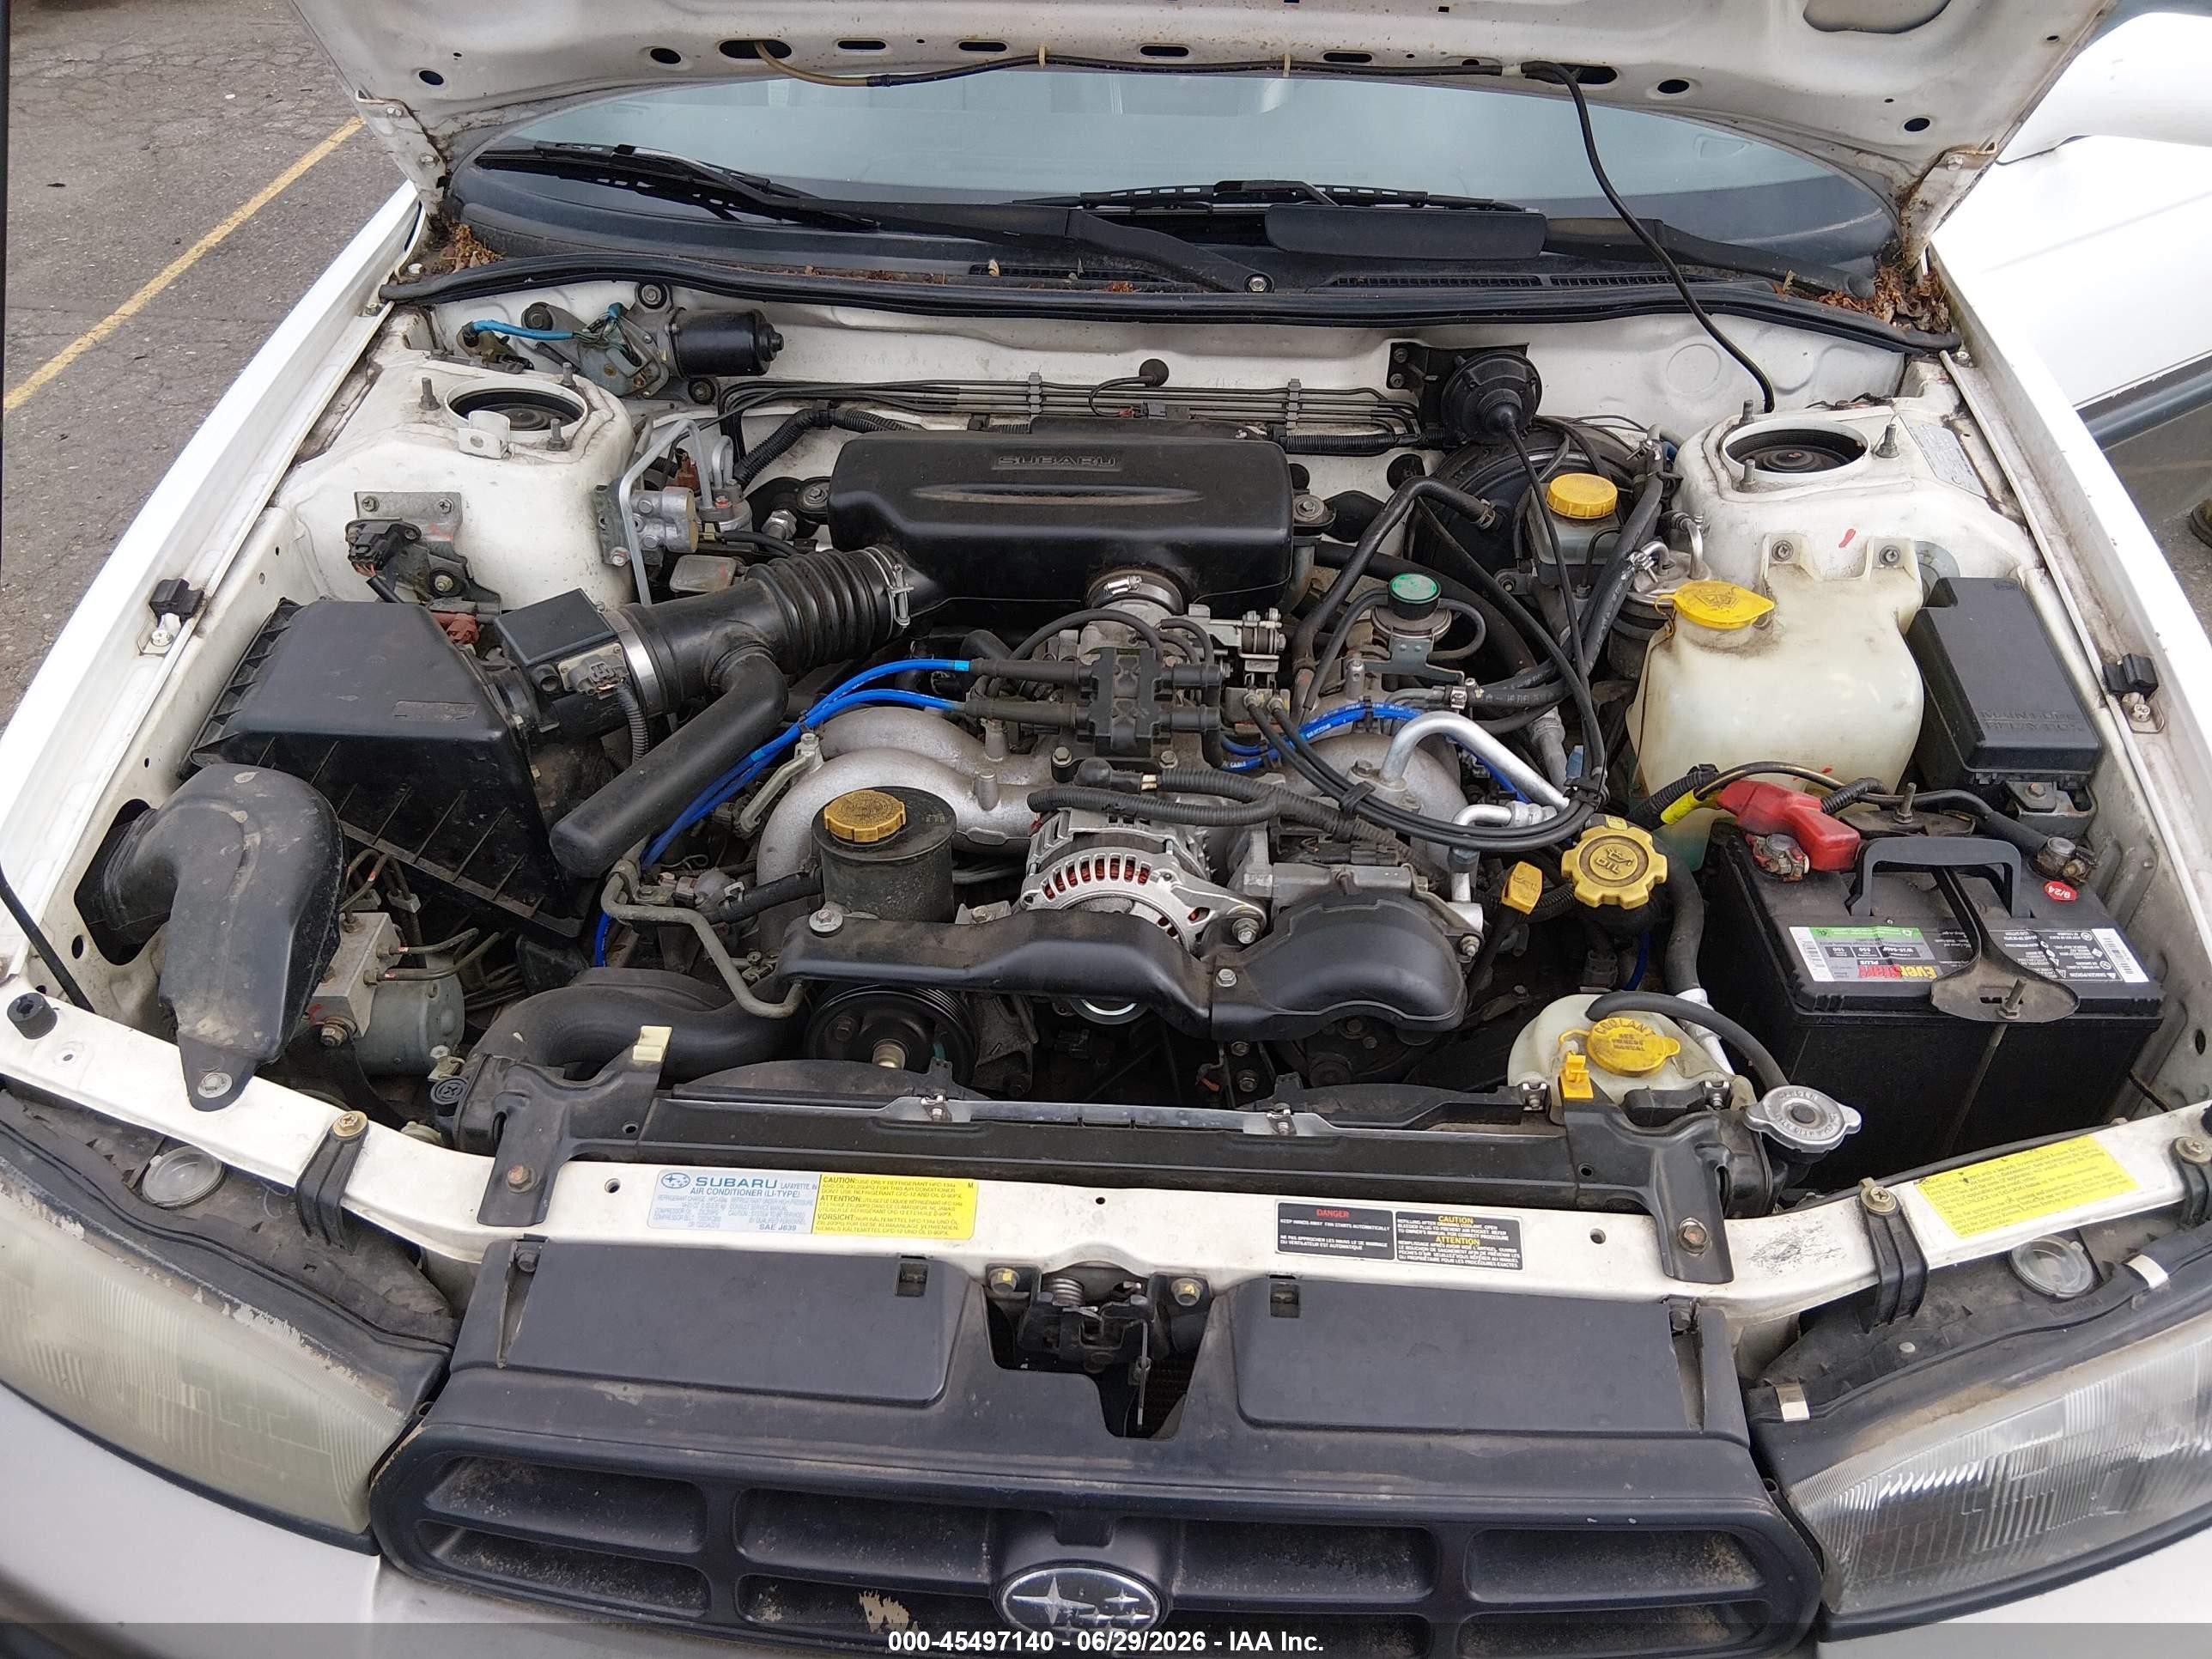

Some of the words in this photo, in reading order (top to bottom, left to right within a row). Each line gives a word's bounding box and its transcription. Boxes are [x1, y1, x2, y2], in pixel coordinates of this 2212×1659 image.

[999, 455, 1115, 467] SUBARU
[1596, 857, 1620, 874] OIL
[696, 1176, 778, 1189] SUBARU
[706, 1188, 763, 1196] CONDITIONER
[1316, 1209, 1349, 1218] DANGER
[1436, 1237, 1480, 1245] ATTENTION
